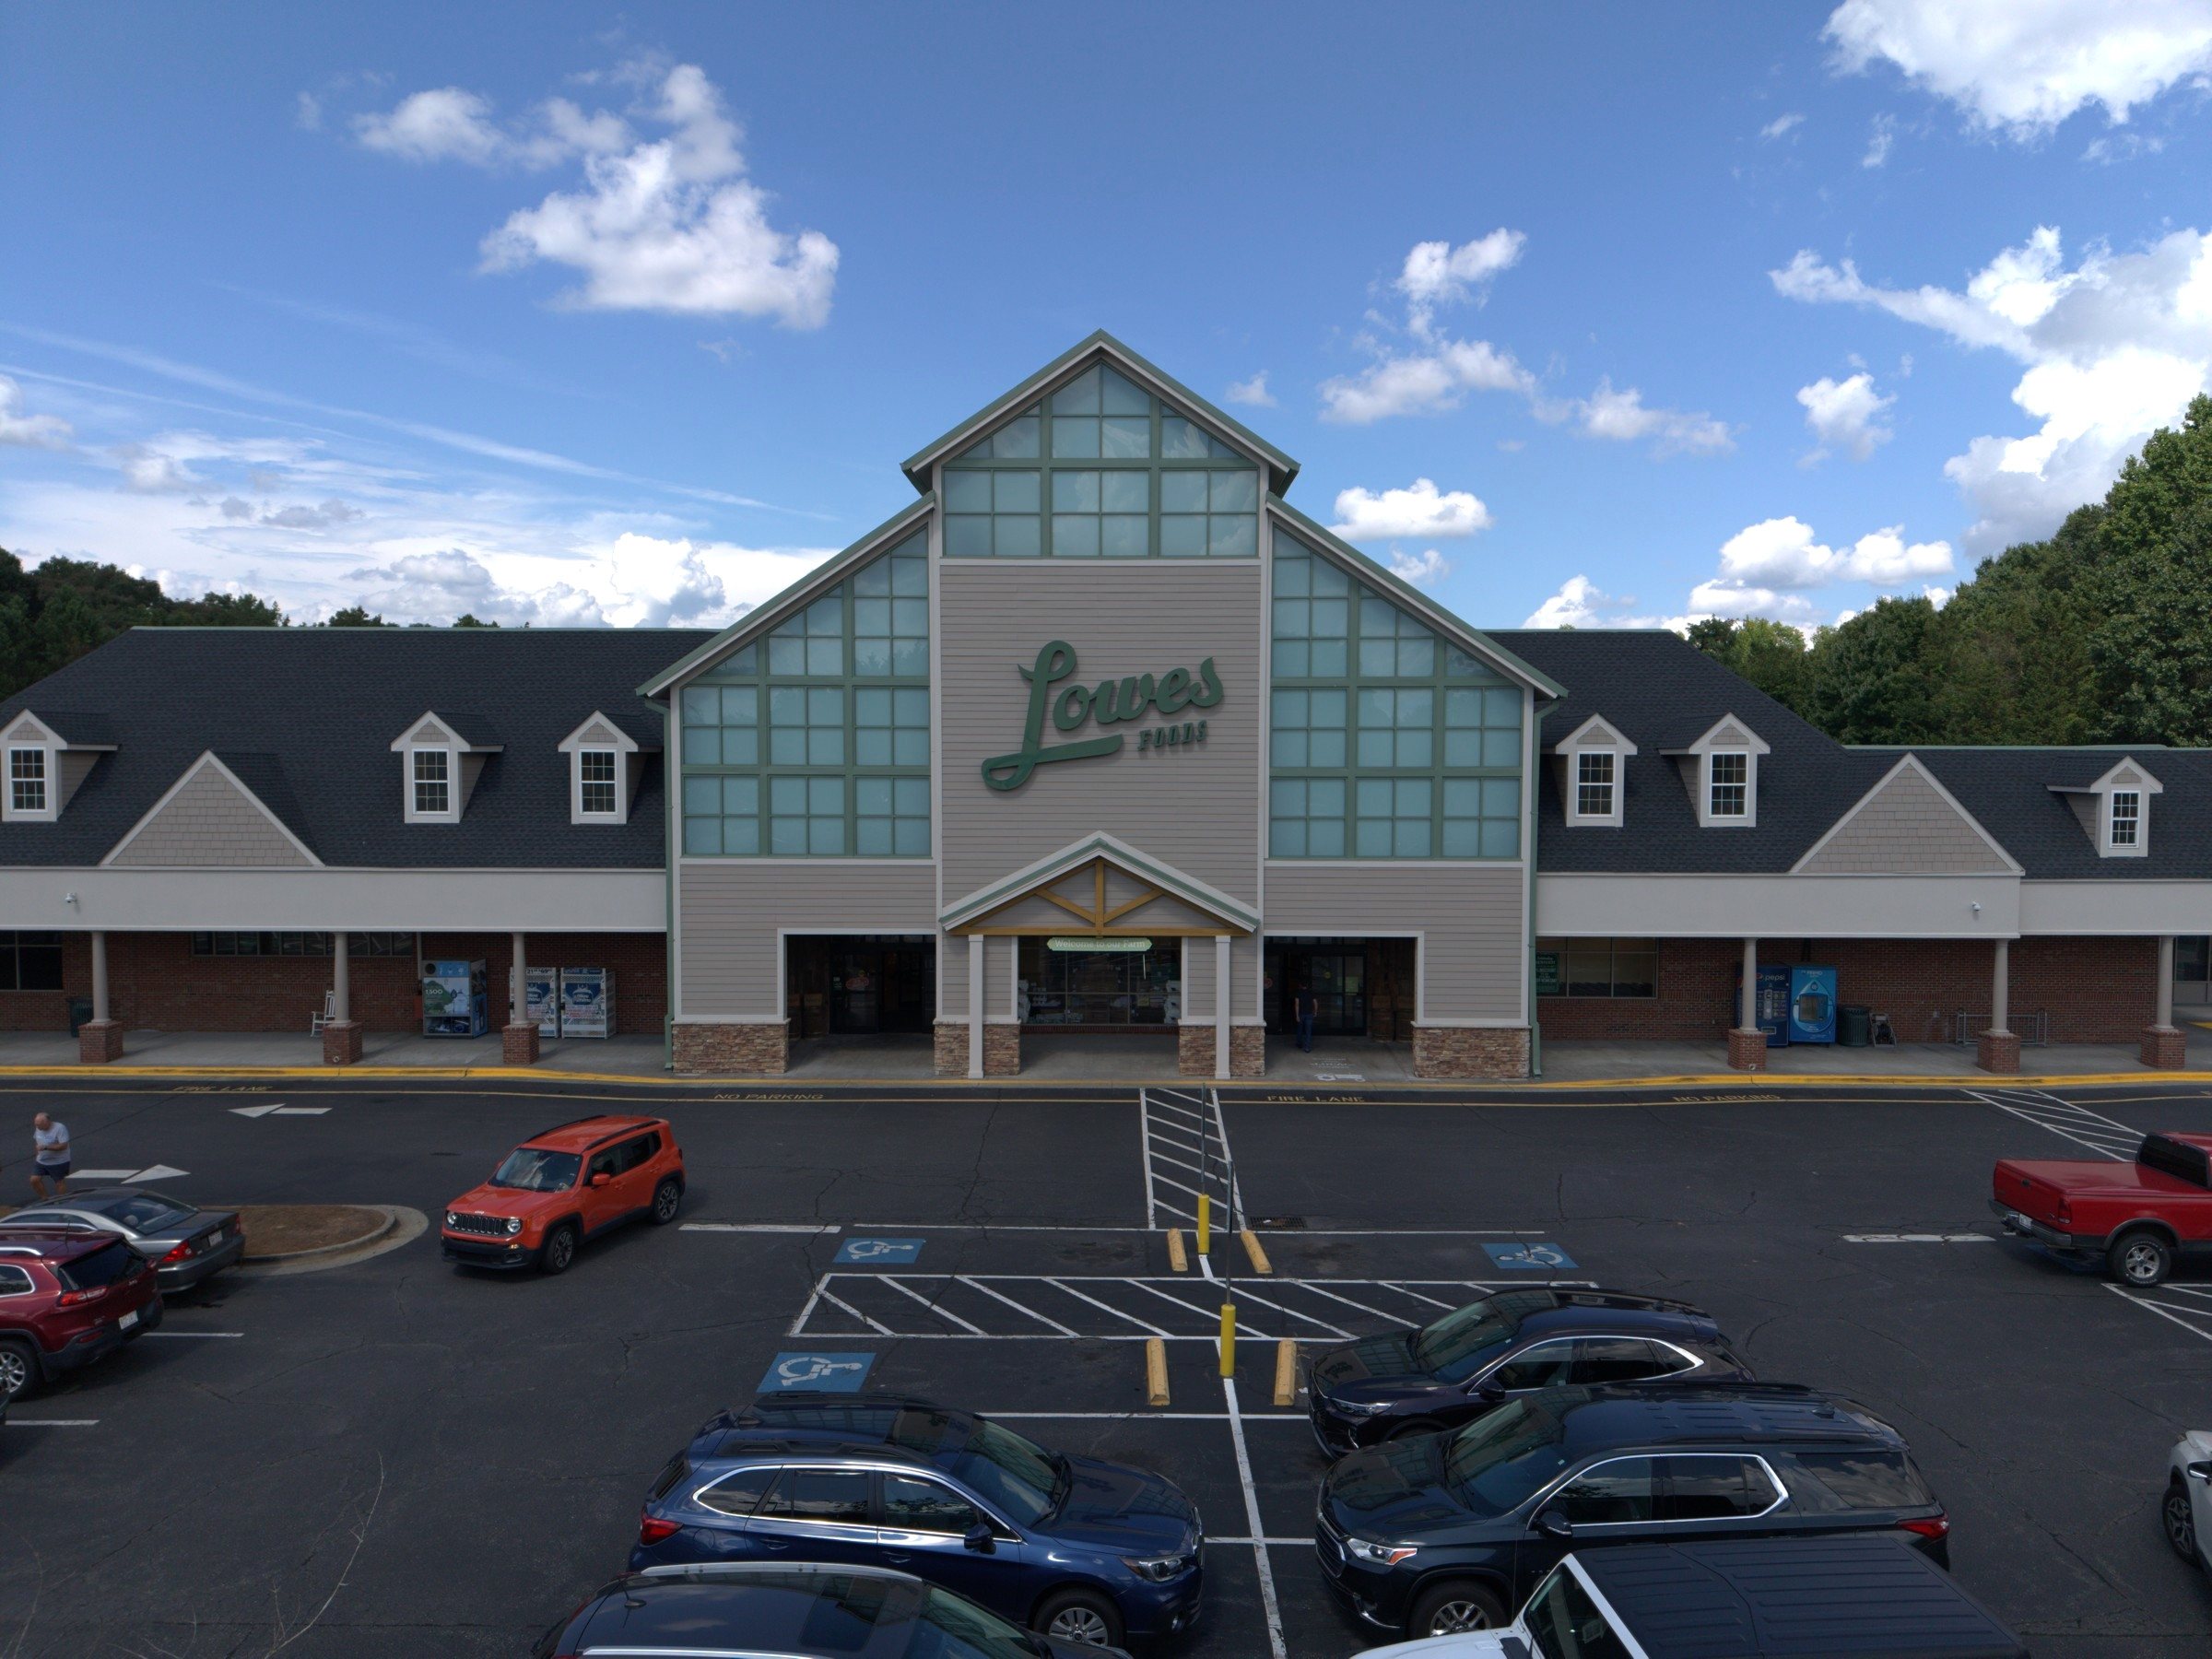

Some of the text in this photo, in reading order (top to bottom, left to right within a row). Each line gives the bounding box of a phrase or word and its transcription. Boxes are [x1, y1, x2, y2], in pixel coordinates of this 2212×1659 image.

[982, 640, 1223, 790] Lowes
[1137, 720, 1207, 750] FOODS
[1054, 939, 1094, 947] Welcome
[1123, 939, 1146, 947] Farm
[1764, 972, 1785, 982] pepsi
